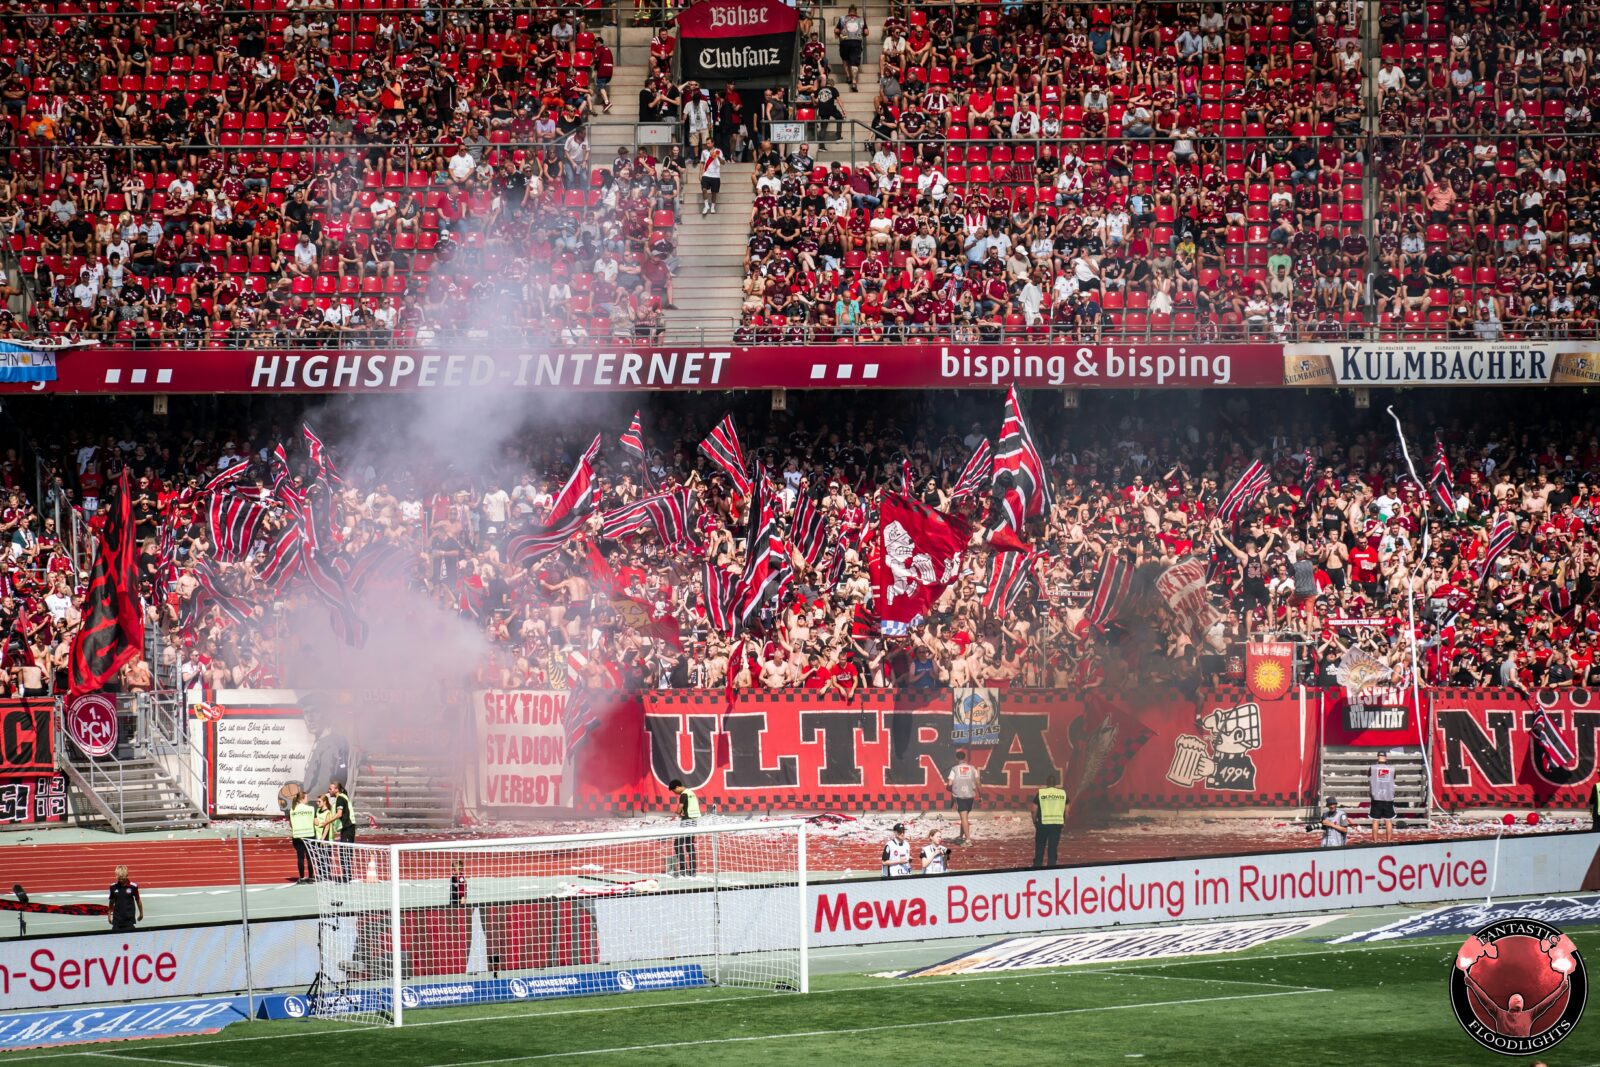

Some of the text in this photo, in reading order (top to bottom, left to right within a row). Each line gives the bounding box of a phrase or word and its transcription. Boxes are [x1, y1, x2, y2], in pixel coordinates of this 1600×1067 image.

[710, 5, 769, 30] Böhse
[698, 45, 782, 70] Clubfanz
[251, 352, 731, 388] HIGHSPEED-INTERNET
[941, 347, 1231, 385] bisping & bisping
[1284, 367, 1331, 384] KULMBACHER
[1341, 346, 1549, 381] KULMBACHER
[1556, 365, 1600, 381] KULMBACHE
[89, 706, 101, 720] 1.
[484, 692, 566, 726] SEKTION
[1349, 708, 1405, 729] RIVALITÄT
[0, 710, 52, 765] CI
[80, 720, 111, 739] FCN
[486, 734, 564, 765] STADION
[1220, 766, 1250, 783] 1994
[226, 790, 235, 799] FC
[486, 774, 563, 806] VERBOT
[815, 851, 1488, 933] Mewa. Berufskleidung im Rundum-Service
